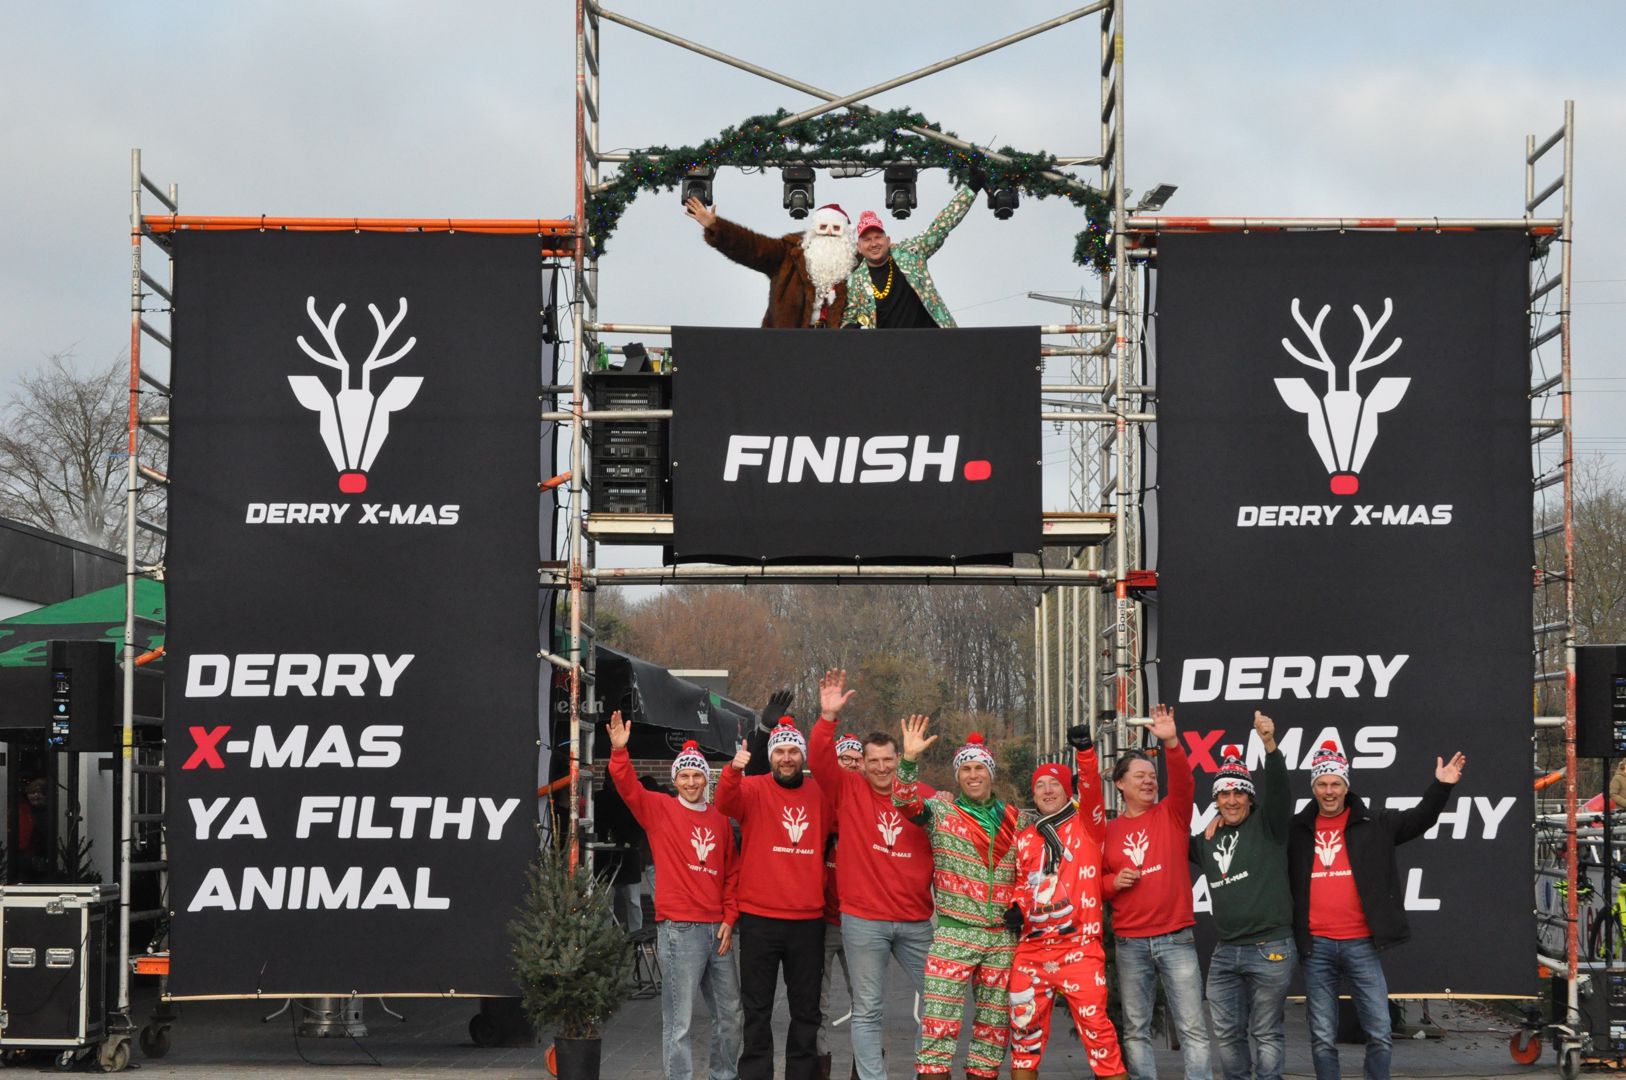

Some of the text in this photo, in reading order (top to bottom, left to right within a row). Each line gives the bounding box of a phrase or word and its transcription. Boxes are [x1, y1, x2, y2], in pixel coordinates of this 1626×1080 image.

[246, 503, 460, 526] DERRY X-MAS
[1237, 504, 1453, 527] DERRY X-MAS
[1118, 600, 1127, 632] Boels
[184, 653, 415, 698] DERRY
[1179, 654, 1409, 703] DERRY
[183, 725, 404, 770] X-MAS
[188, 796, 520, 840] YA FILTHY
[772, 845, 794, 854] DERRY
[1079, 865, 1096, 880] HO
[1225, 870, 1249, 885] X-MAS
[186, 866, 450, 912] ANIMAL
[1081, 891, 1096, 909] ho
[1083, 922, 1100, 935] HO
[1065, 951, 1083, 963] HO
[1079, 1005, 1097, 1018] HO
[1091, 1048, 1108, 1060] HO
[1014, 1060, 1032, 1069] HO
